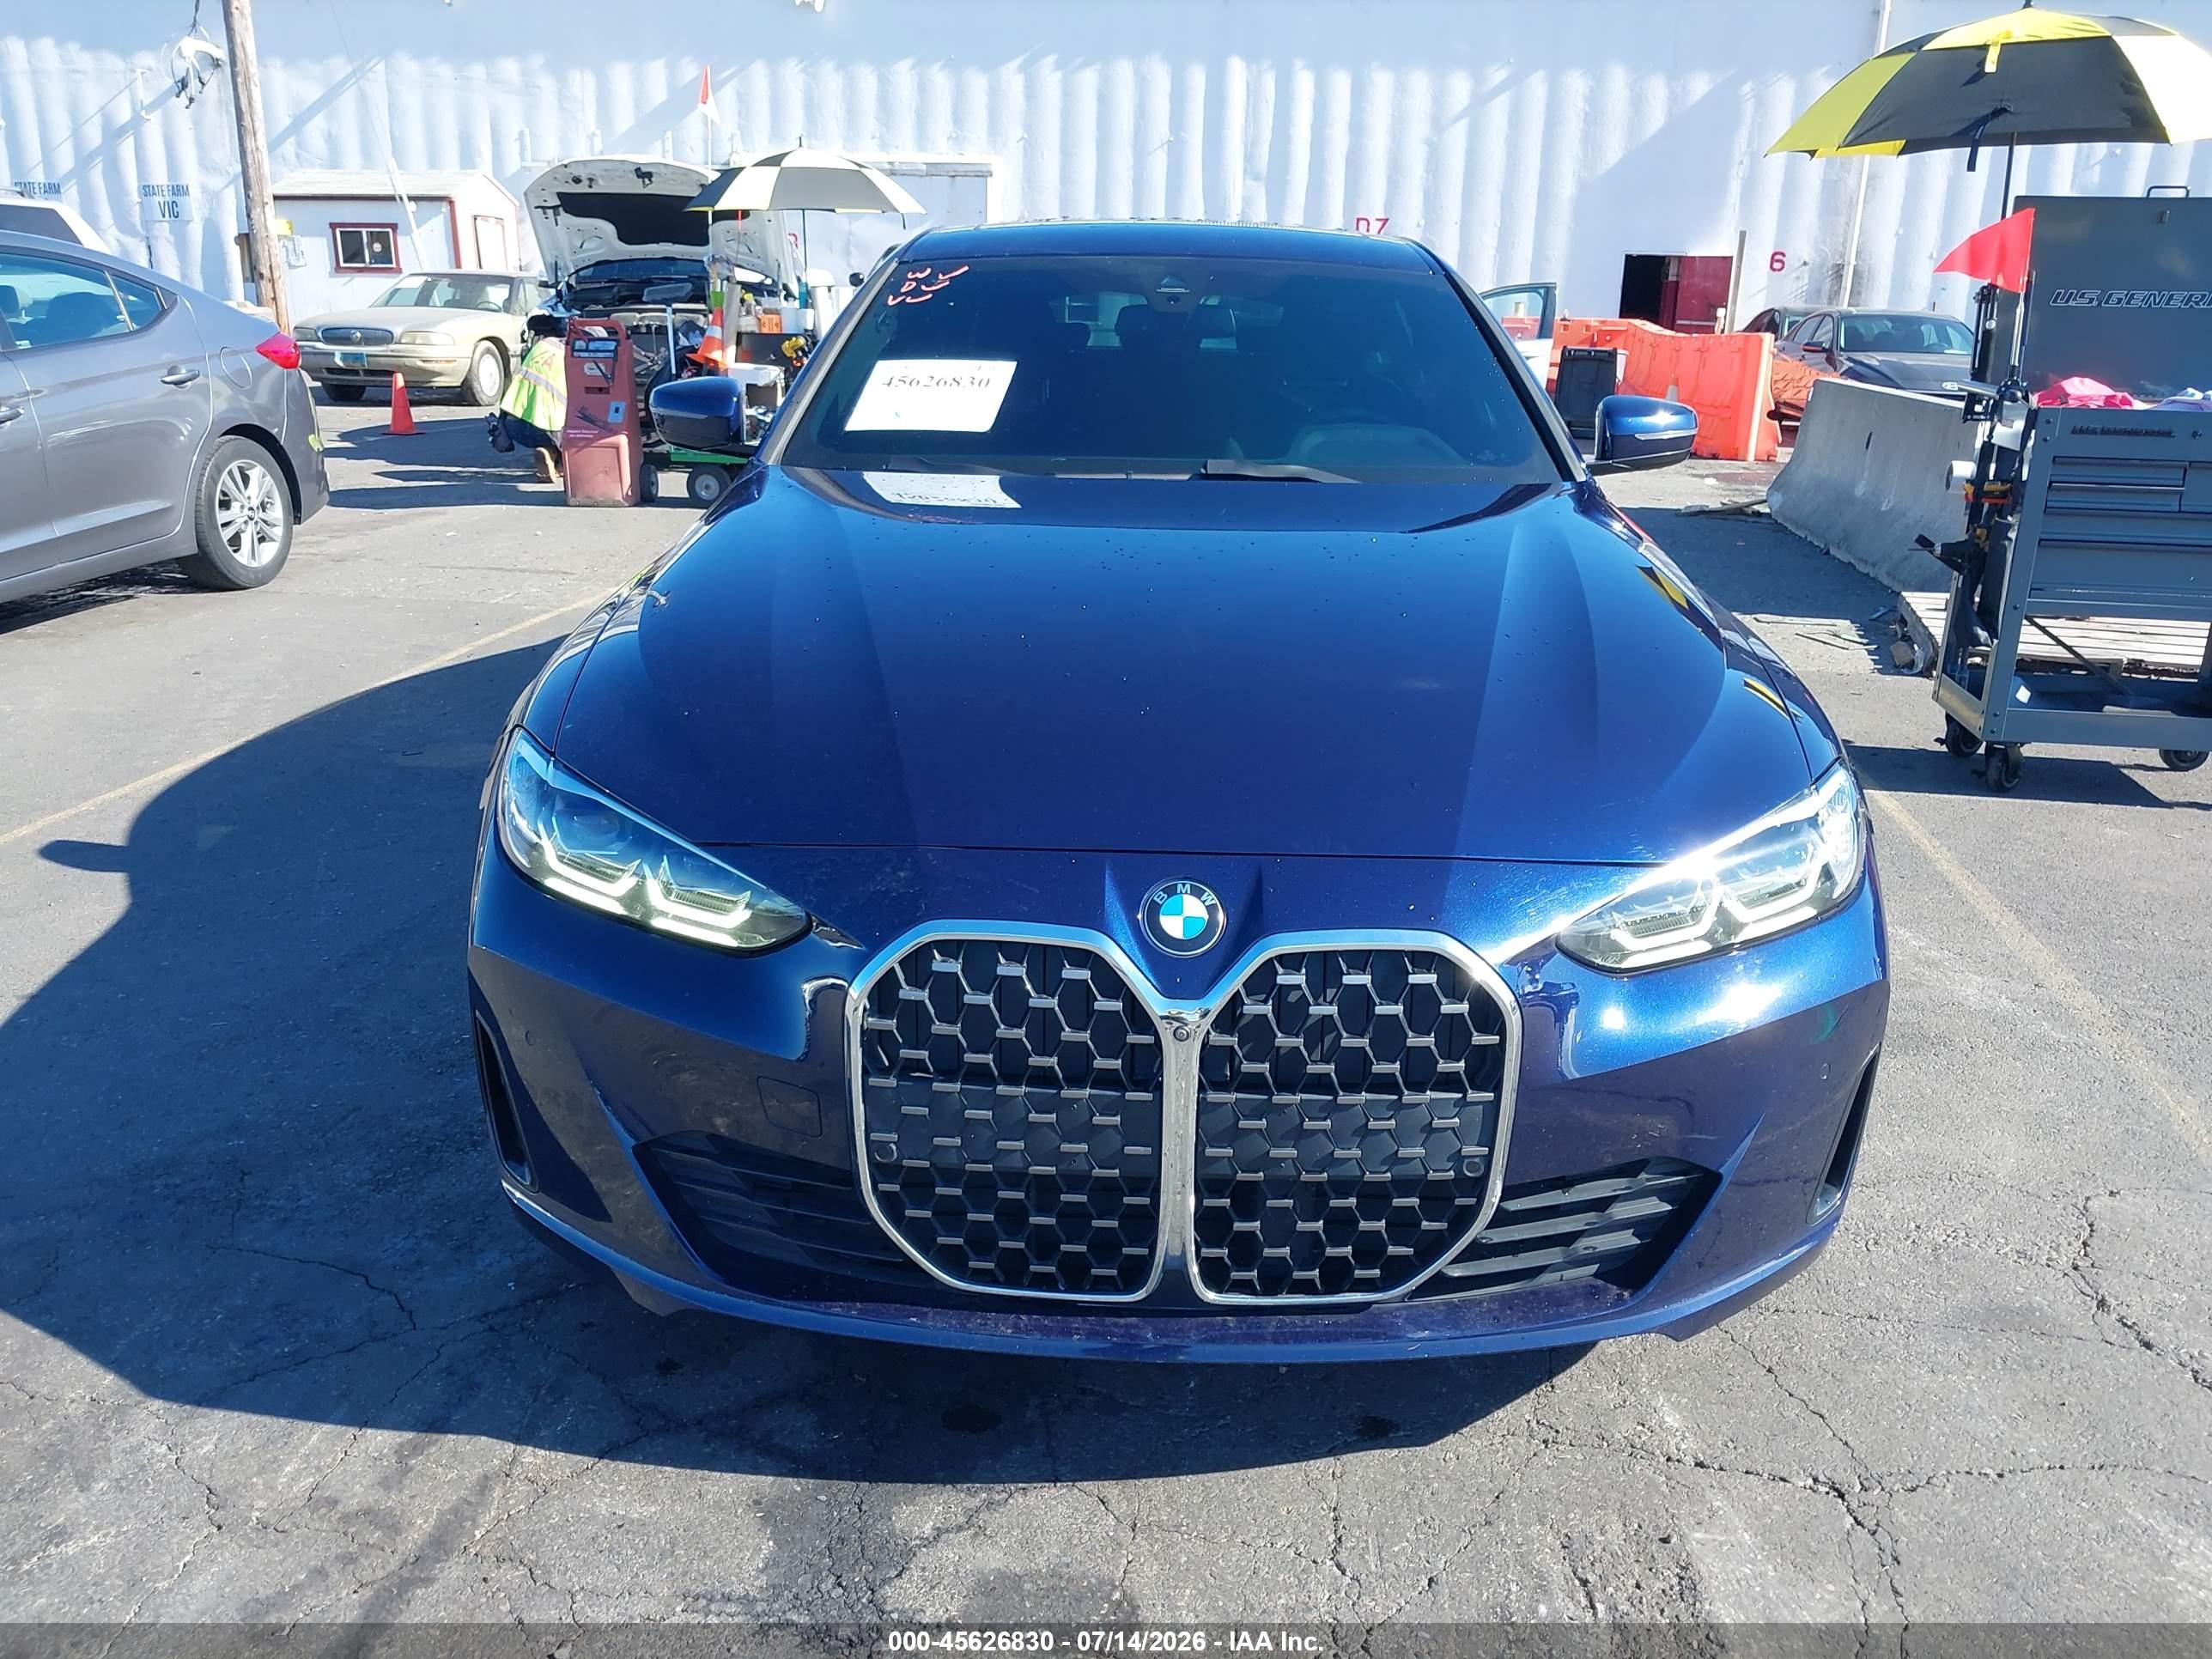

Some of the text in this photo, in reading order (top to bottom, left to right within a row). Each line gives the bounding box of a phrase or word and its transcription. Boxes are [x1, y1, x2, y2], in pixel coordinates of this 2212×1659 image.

[38, 181, 62, 195] FARM
[142, 184, 190, 198] STATE FARM
[157, 200, 179, 219] VIC
[1770, 251, 1786, 272] 6
[882, 375, 990, 389] 45626830
[1152, 883, 1217, 907] BMW
